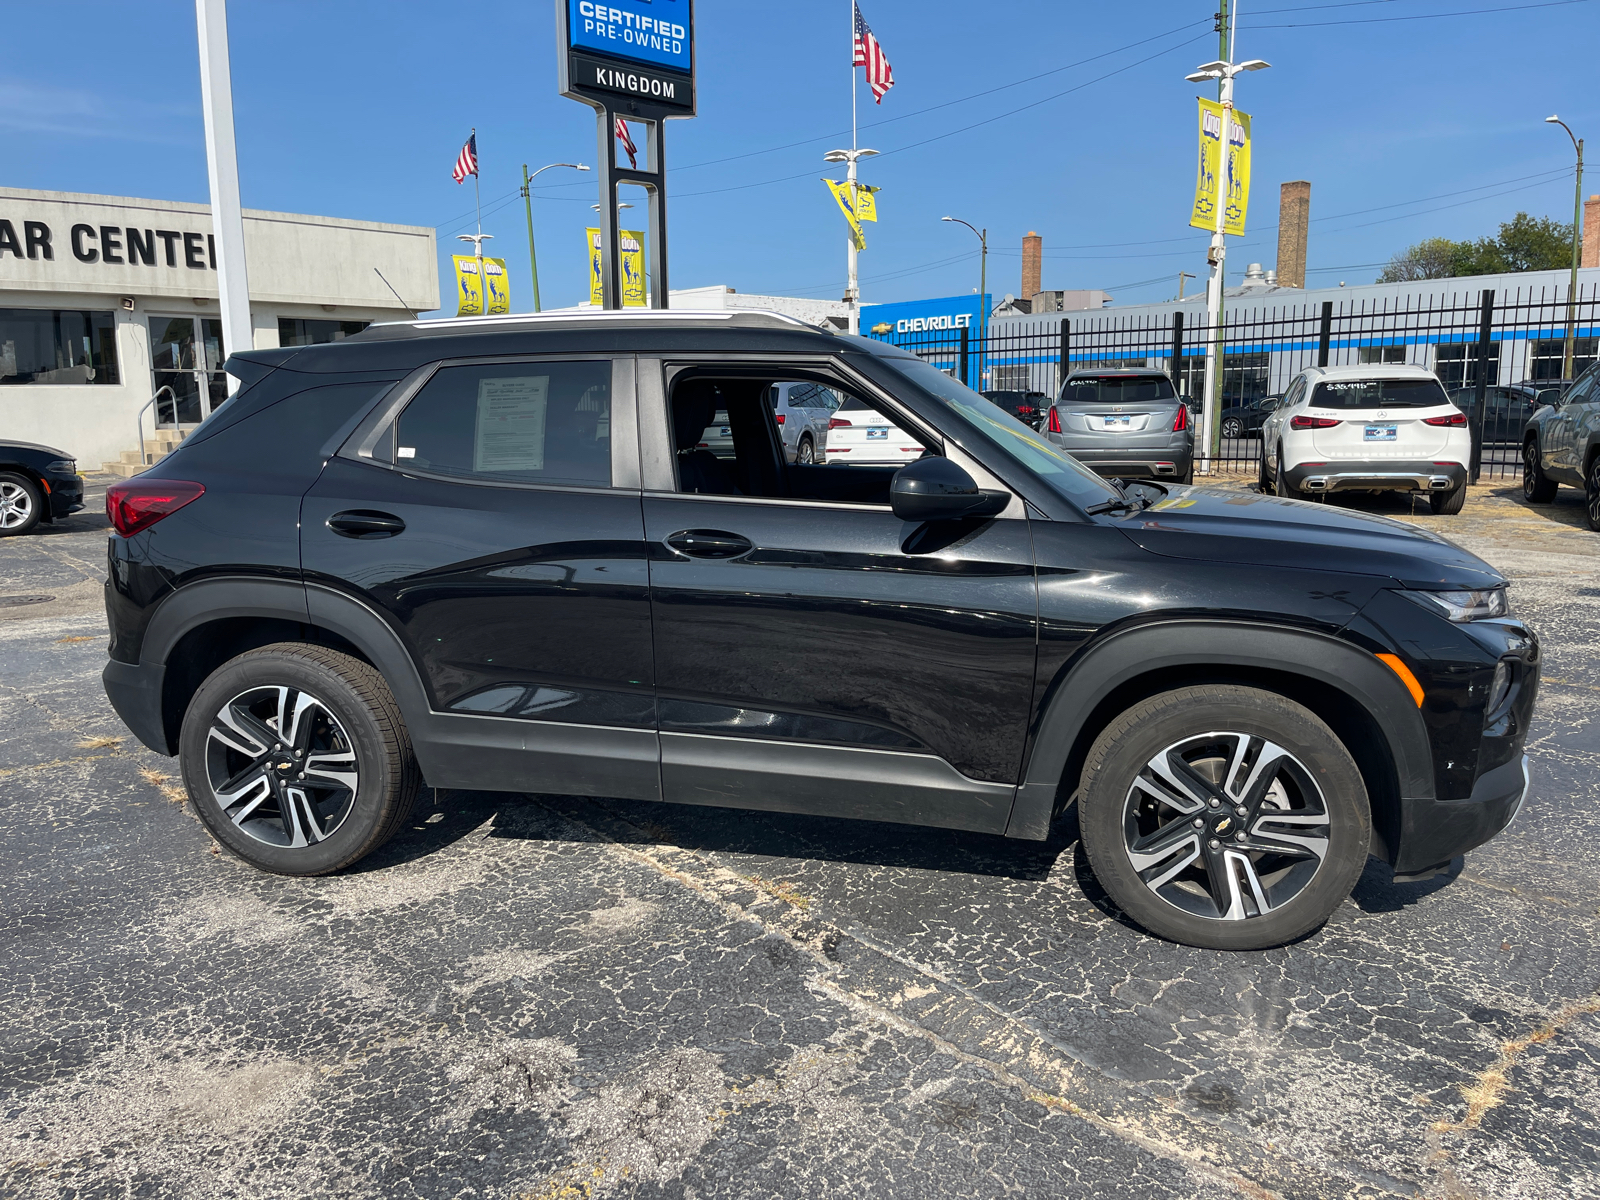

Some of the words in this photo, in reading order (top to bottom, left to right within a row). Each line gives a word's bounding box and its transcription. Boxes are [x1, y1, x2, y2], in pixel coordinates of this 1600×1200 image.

[579, 1, 685, 39] CERTIFIED
[585, 19, 682, 54] PRE-OWNED
[596, 67, 675, 98] KINGDOM
[1203, 109, 1221, 138] King
[621, 237, 640, 250] dom
[458, 260, 477, 273] King
[485, 262, 503, 274] dom
[896, 313, 972, 333] CHEVROLET
